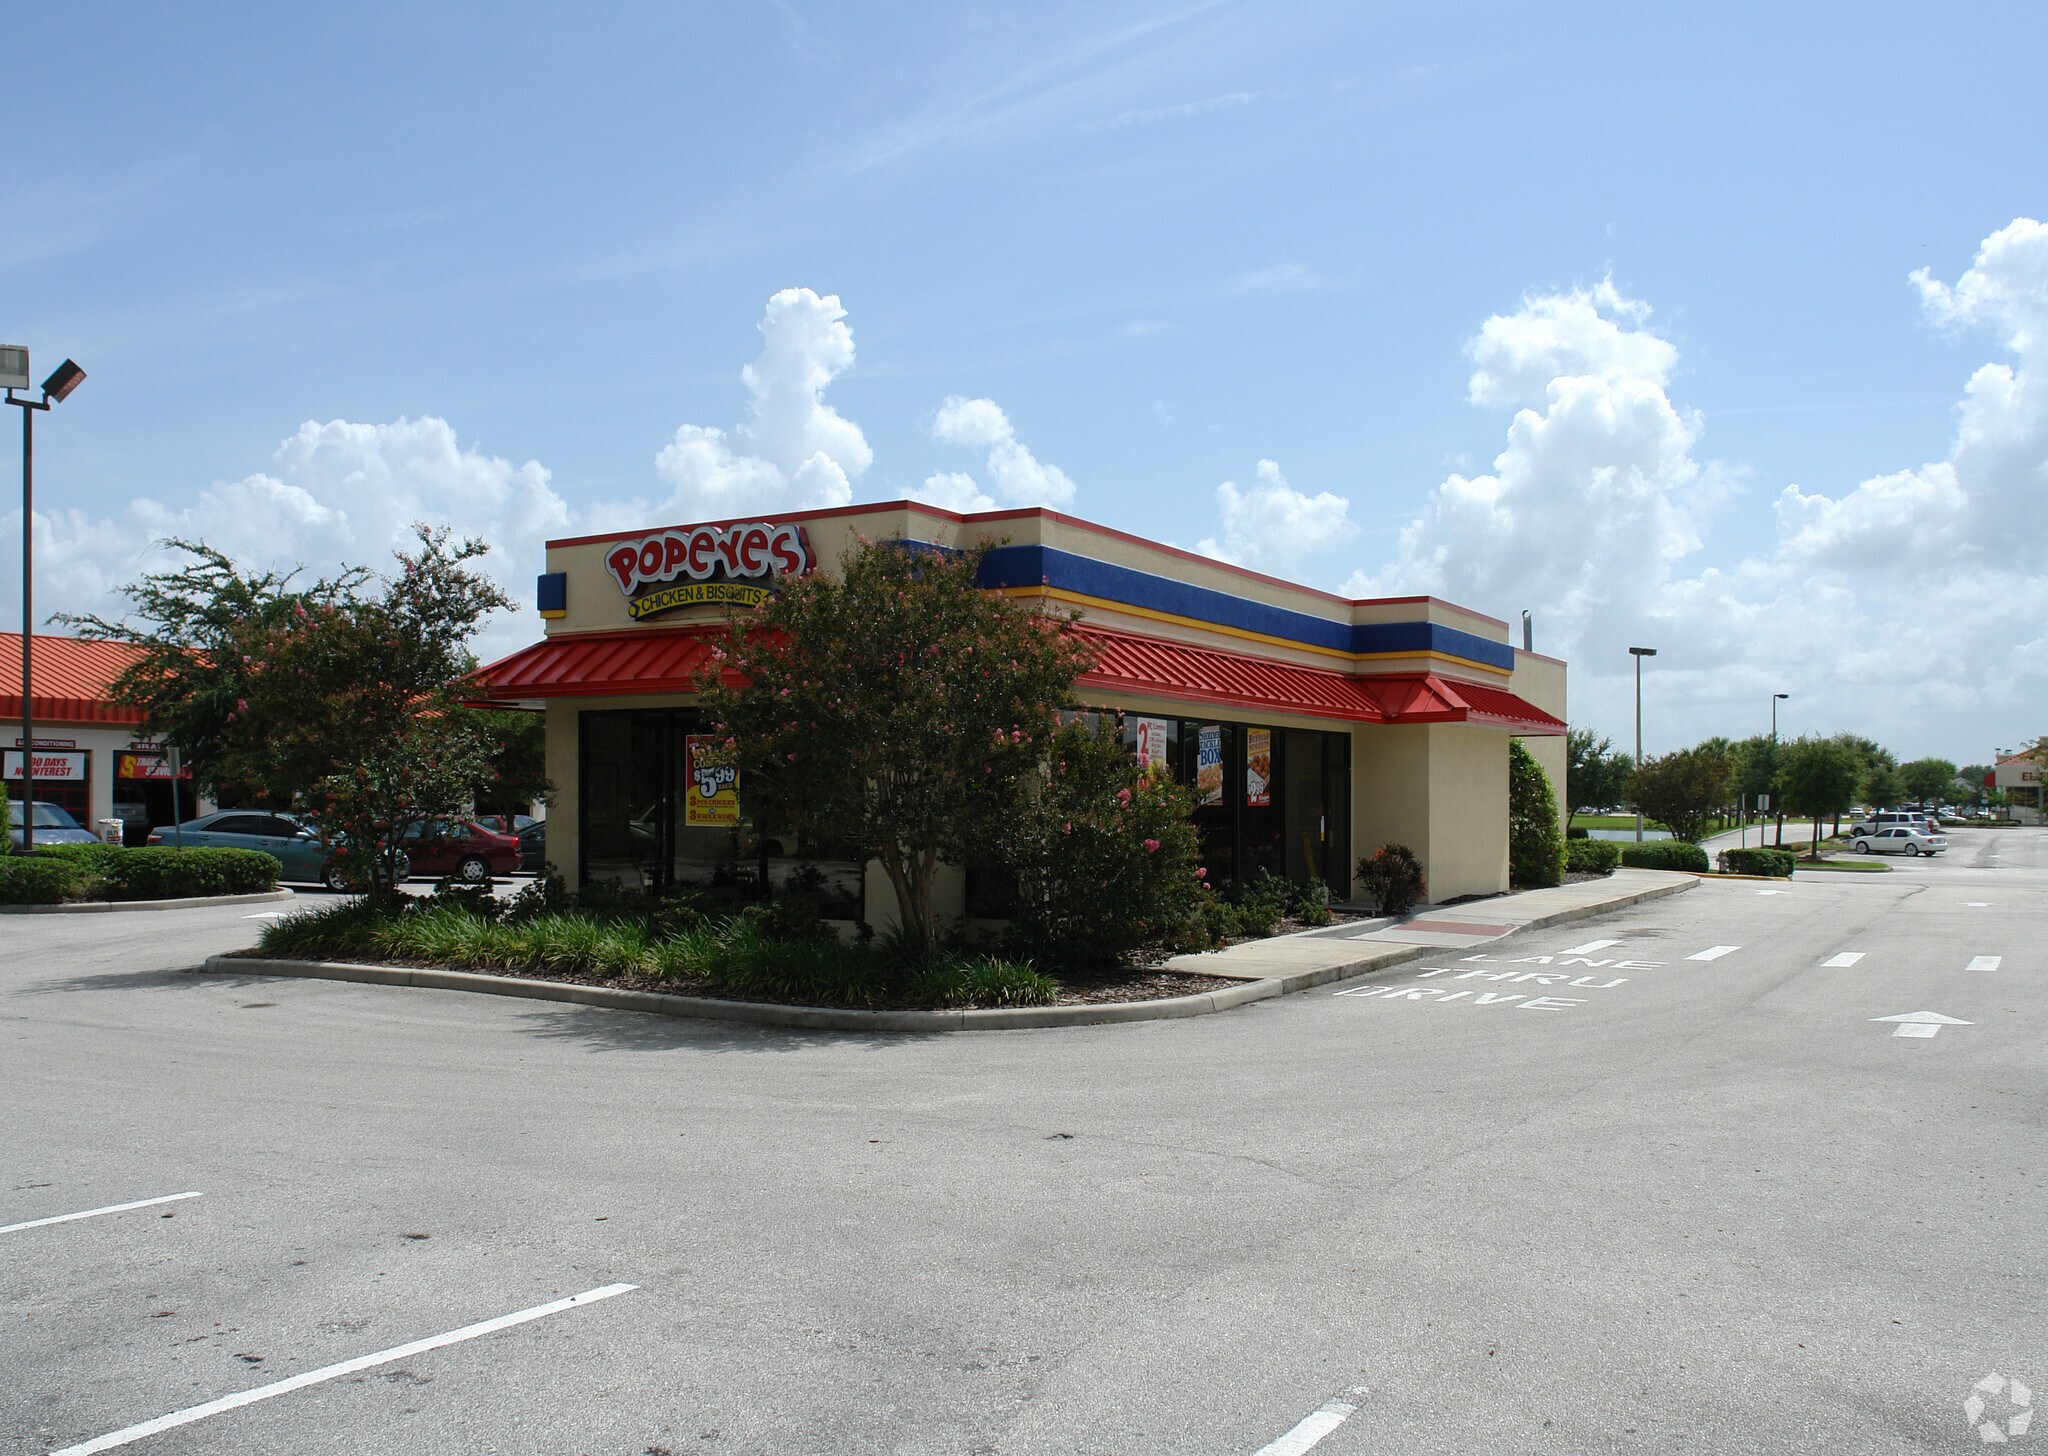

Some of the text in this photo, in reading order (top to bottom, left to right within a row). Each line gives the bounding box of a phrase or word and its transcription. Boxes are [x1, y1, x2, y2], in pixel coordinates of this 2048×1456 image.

[641, 585, 762, 612] CHICKEN & BISCUITS
[1138, 722, 1149, 755] 2
[44, 757, 68, 767] DAYS
[1200, 748, 1221, 765] BOX
[689, 795, 697, 807] 3
[689, 809, 697, 820] 3
[1458, 953, 1669, 970] LANE
[1416, 967, 1629, 988] THRU
[1332, 985, 1589, 1011] DRIVE
